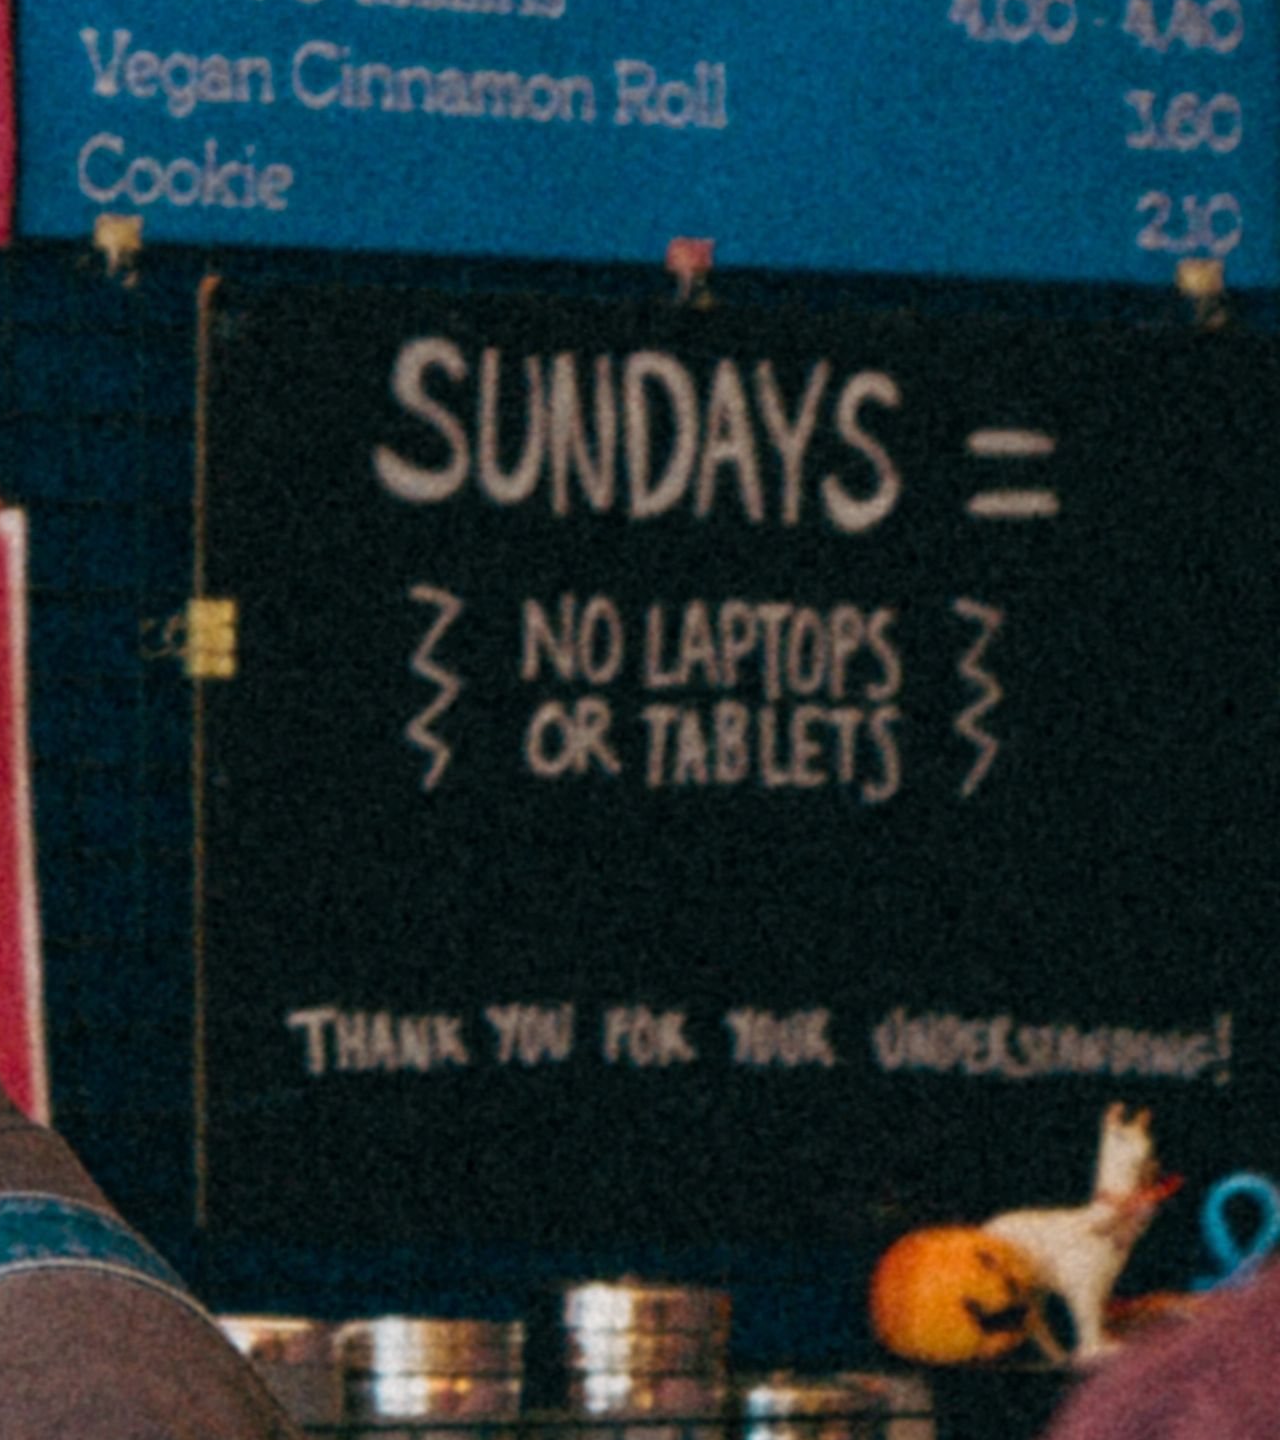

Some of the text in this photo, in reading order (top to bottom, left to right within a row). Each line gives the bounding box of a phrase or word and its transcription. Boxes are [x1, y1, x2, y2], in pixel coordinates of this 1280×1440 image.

[79, 26, 277, 119] Vegan
[291, 40, 598, 124] Cinnamon
[613, 57, 730, 131] Roll
[77, 131, 295, 212] Cookie
[372, 335, 903, 535] SUNDAYS
[520, 592, 904, 706] NO LAPTOPS
[521, 697, 904, 805] OR TABLETS
[285, 1002, 470, 1079] THANK
[484, 999, 576, 1068] YOU
